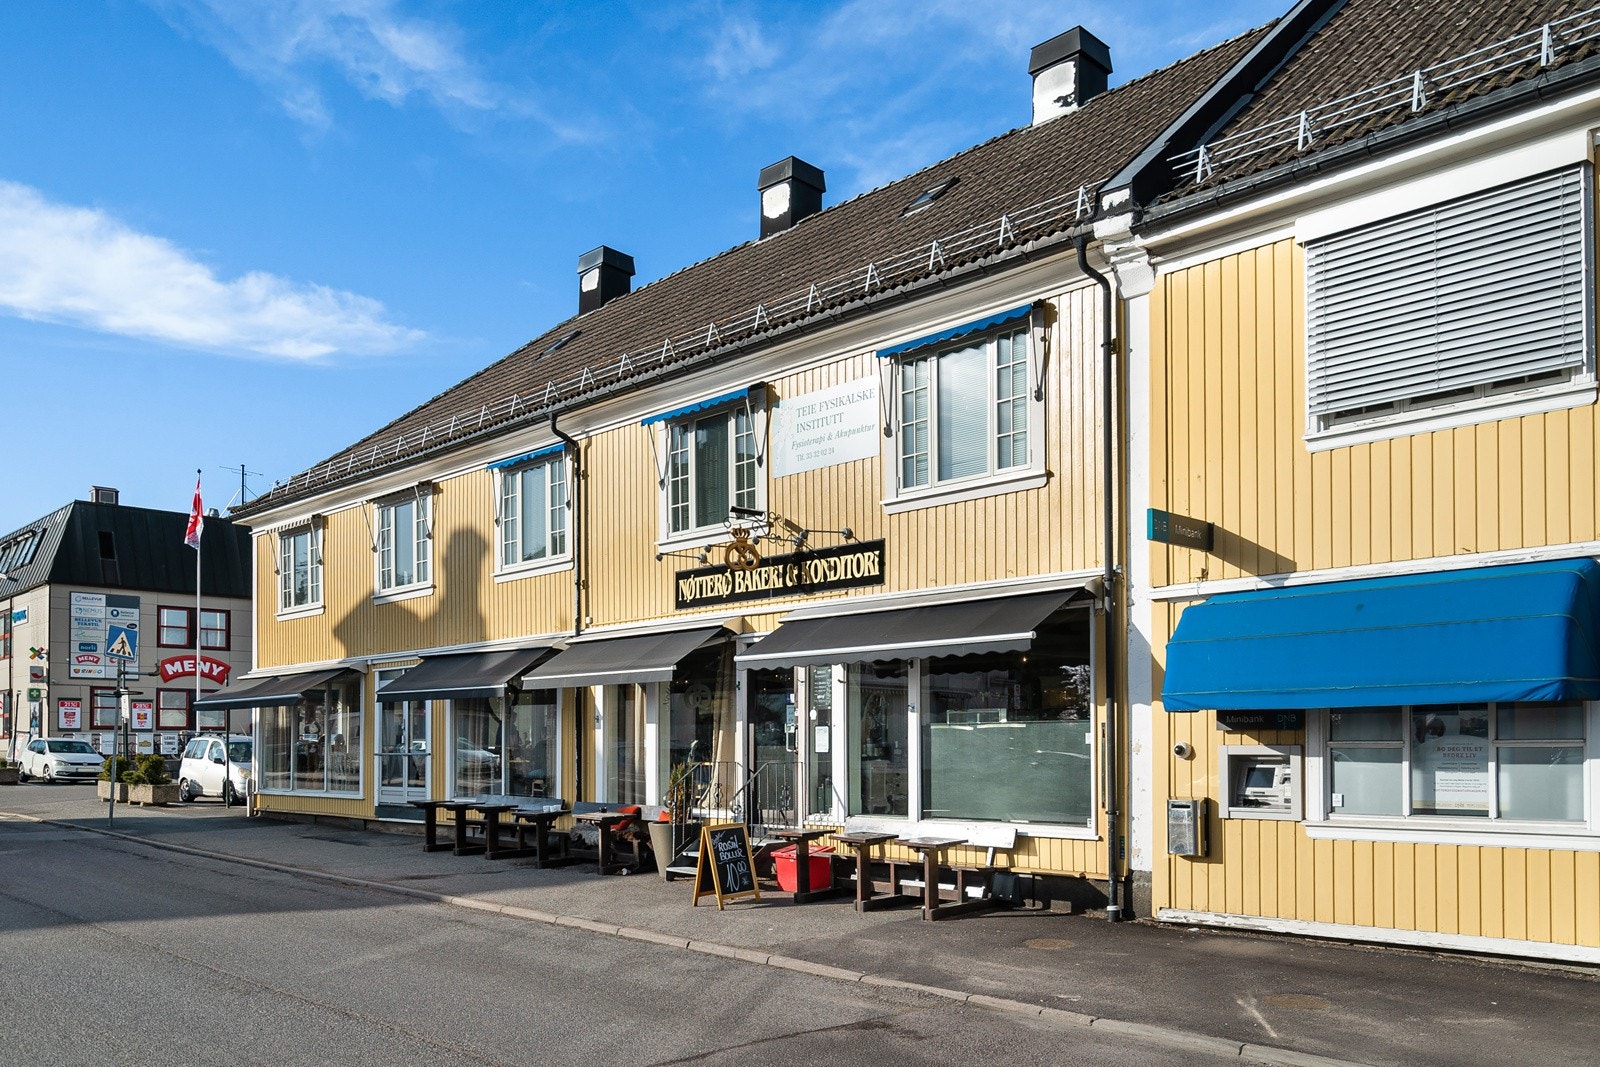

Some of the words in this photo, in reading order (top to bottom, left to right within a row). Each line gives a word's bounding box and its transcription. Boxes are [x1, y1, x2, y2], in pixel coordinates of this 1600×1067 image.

[796, 403, 817, 418] TEIE
[819, 388, 876, 411] FYSIKALSKE
[796, 412, 845, 433] INSTITUTT
[791, 433, 826, 450] Fysioterapi
[826, 431, 833, 441] &
[834, 423, 876, 439] Akupunktur
[1174, 524, 1202, 539] Minibank
[678, 569, 733, 603] NØTTERØ
[734, 564, 784, 594] BAKERI
[785, 562, 799, 588] &
[802, 550, 881, 585] KONDITORI
[77, 655, 99, 663] MENY
[164, 660, 225, 676] MENY
[1226, 714, 1265, 724] Minibank
[1277, 713, 1297, 728] DNB
[719, 848, 746, 860] BOLLER
